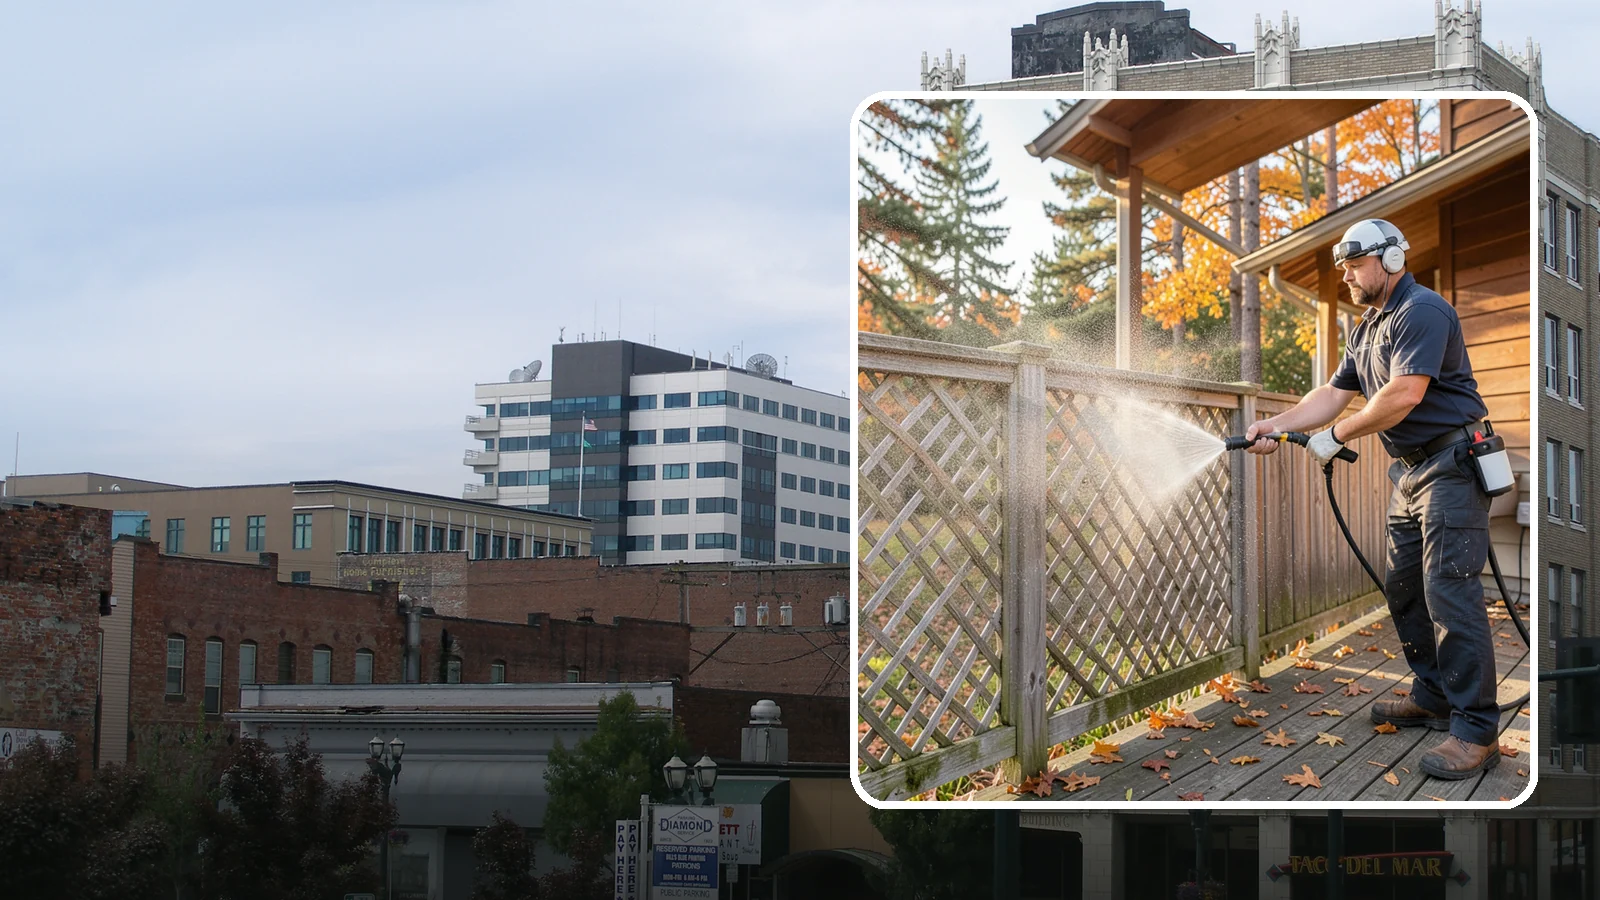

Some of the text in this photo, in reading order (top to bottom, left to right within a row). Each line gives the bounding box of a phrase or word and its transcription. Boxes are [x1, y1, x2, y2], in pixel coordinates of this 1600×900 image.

[660, 818, 713, 832] DIAMOND
[1022, 815, 1069, 827] BUILDING
[656, 845, 716, 854] RESERVED PARKING
[617, 825, 625, 893] PAY HERE
[627, 825, 637, 893] PAY HERE
[721, 851, 739, 863] Soup
[671, 862, 701, 870] PATRONS
[1289, 856, 1442, 877] TAC DEL MAR
[660, 888, 710, 898] PUBLIC PARKING
